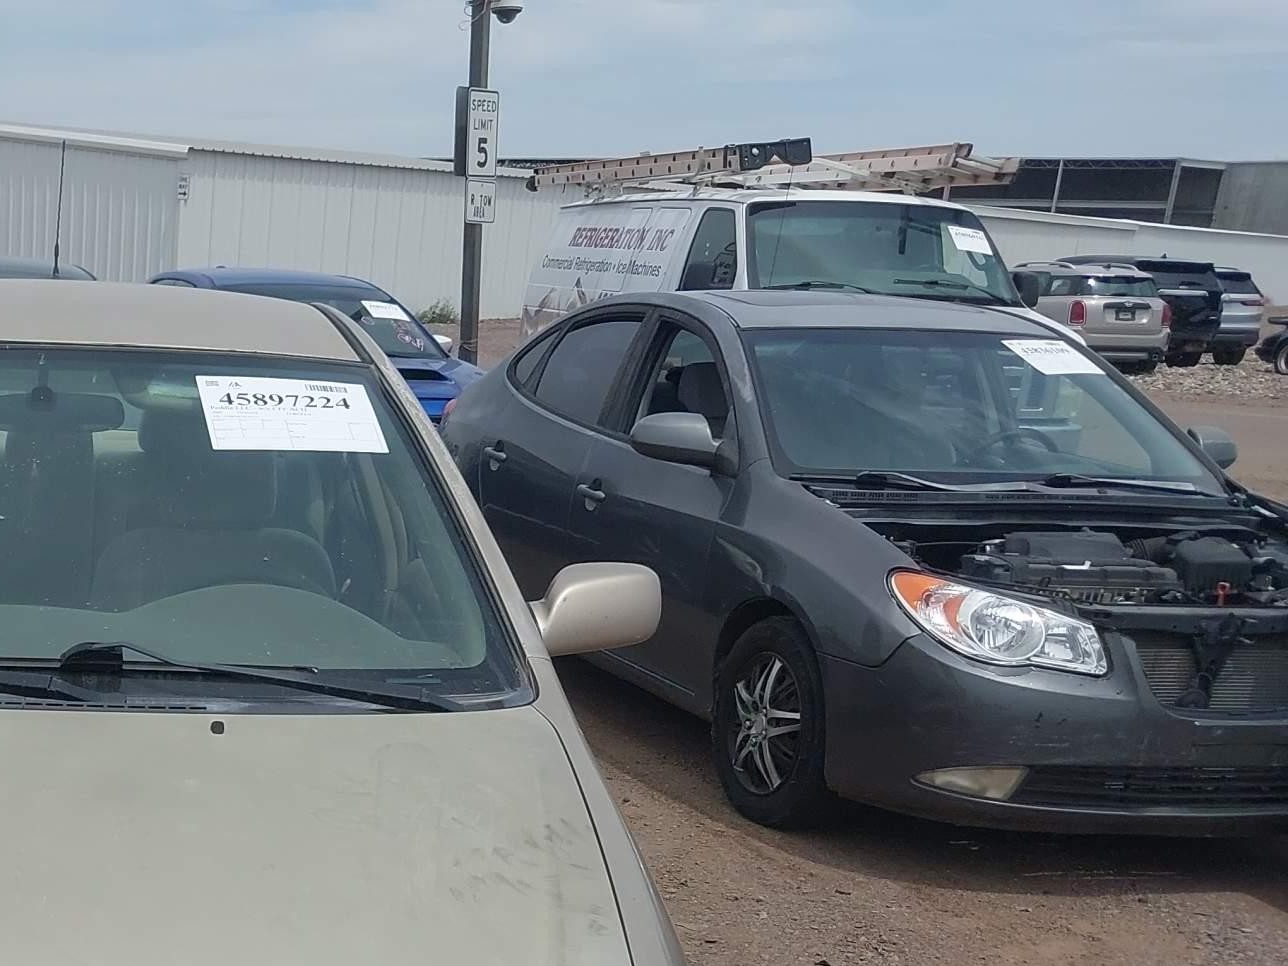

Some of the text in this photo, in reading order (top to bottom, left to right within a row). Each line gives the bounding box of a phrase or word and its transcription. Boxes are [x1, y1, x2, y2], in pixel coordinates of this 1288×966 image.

[471, 99, 497, 113] SPEED
[473, 119, 494, 131] LIMIT
[476, 137, 488, 168] 5
[479, 194, 493, 208] TOW
[568, 226, 676, 252] REFRIGERATION, INC
[542, 254, 662, 277] Commercial Refrigeration Ice Machines
[219, 392, 351, 410] 45897224
